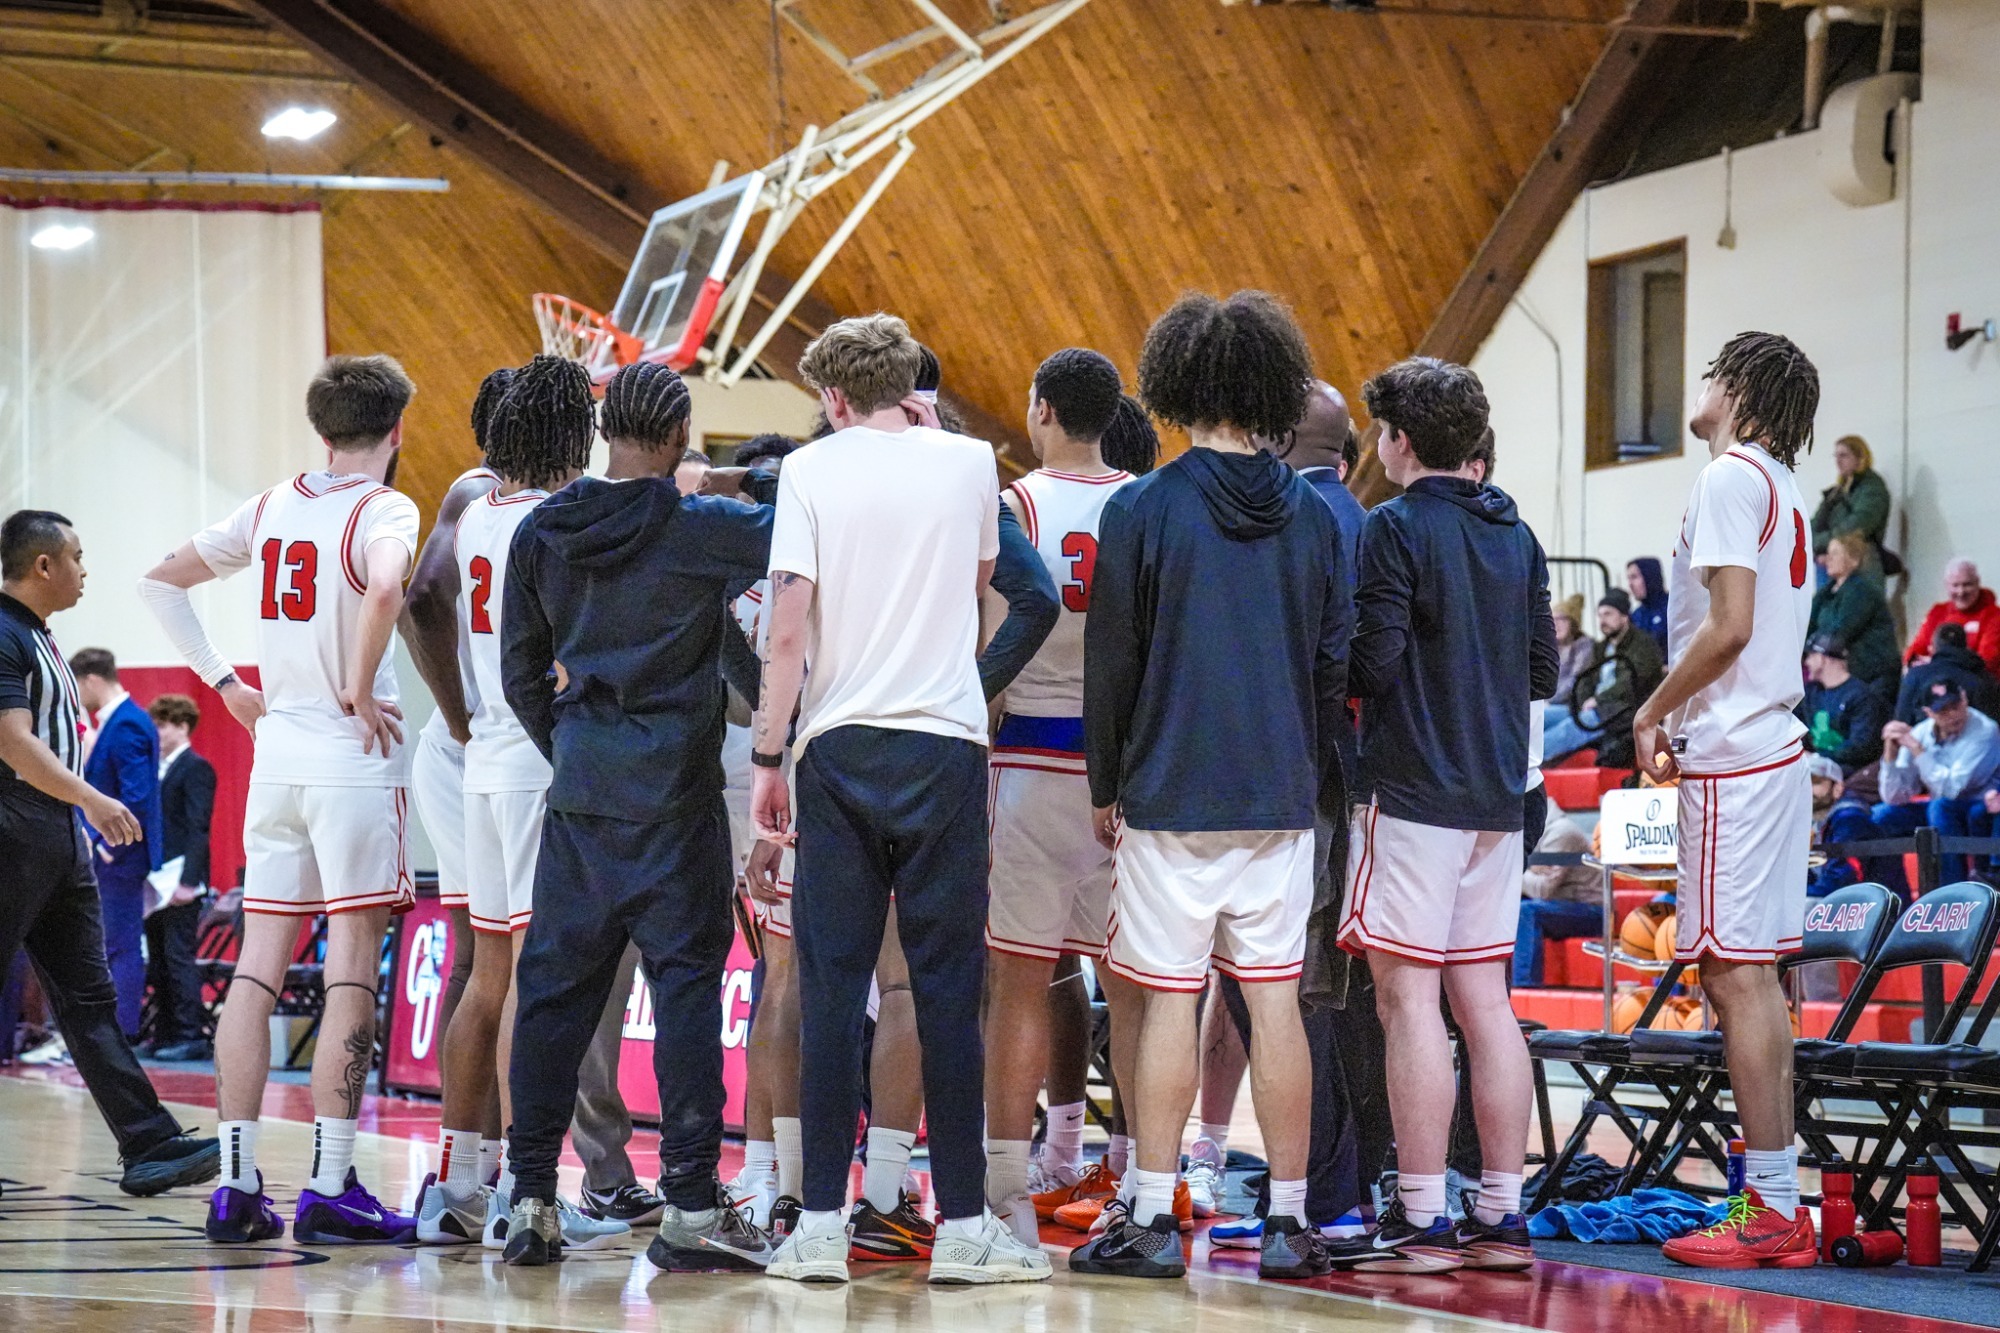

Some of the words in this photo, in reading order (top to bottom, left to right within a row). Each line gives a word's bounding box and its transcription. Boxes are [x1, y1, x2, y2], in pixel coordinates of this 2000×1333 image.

[261, 538, 318, 622] 13
[469, 555, 494, 634] 2
[1061, 532, 1098, 612] 3
[1805, 902, 1877, 932] CLARK
[1902, 901, 1982, 932] CLARK
[775, 1199, 795, 1210] GT
